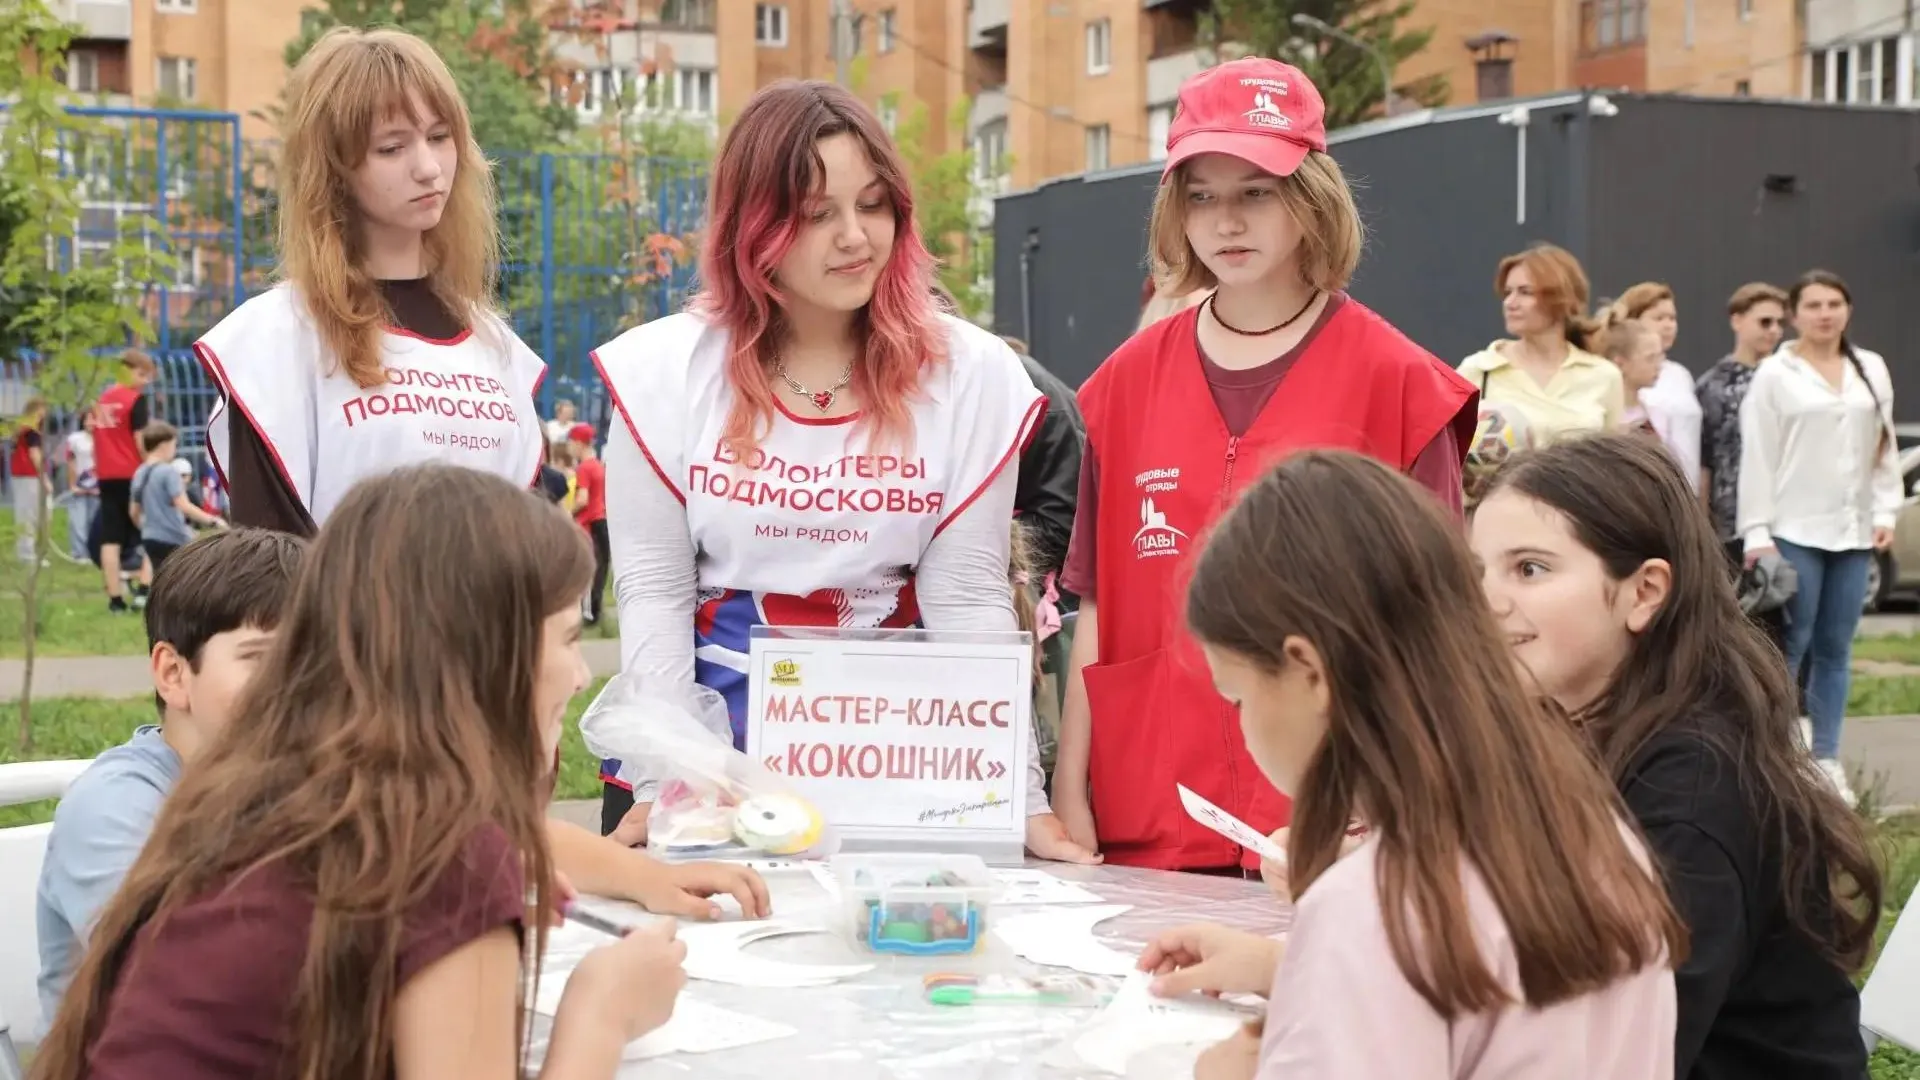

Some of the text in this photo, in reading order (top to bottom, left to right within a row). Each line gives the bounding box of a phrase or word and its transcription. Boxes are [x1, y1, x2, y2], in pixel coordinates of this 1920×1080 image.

[359, 366, 511, 398] ОЛОНТЕР
[423, 431, 502, 451] МЫ РЯДОМ
[689, 464, 944, 515] ПОДМОСКОВЬЯ
[754, 524, 869, 544] МЫ РЯДОМ
[764, 694, 1010, 728] МАСТЕР-КЛАСС
[763, 742, 1007, 782] «КОКОШНИК»
